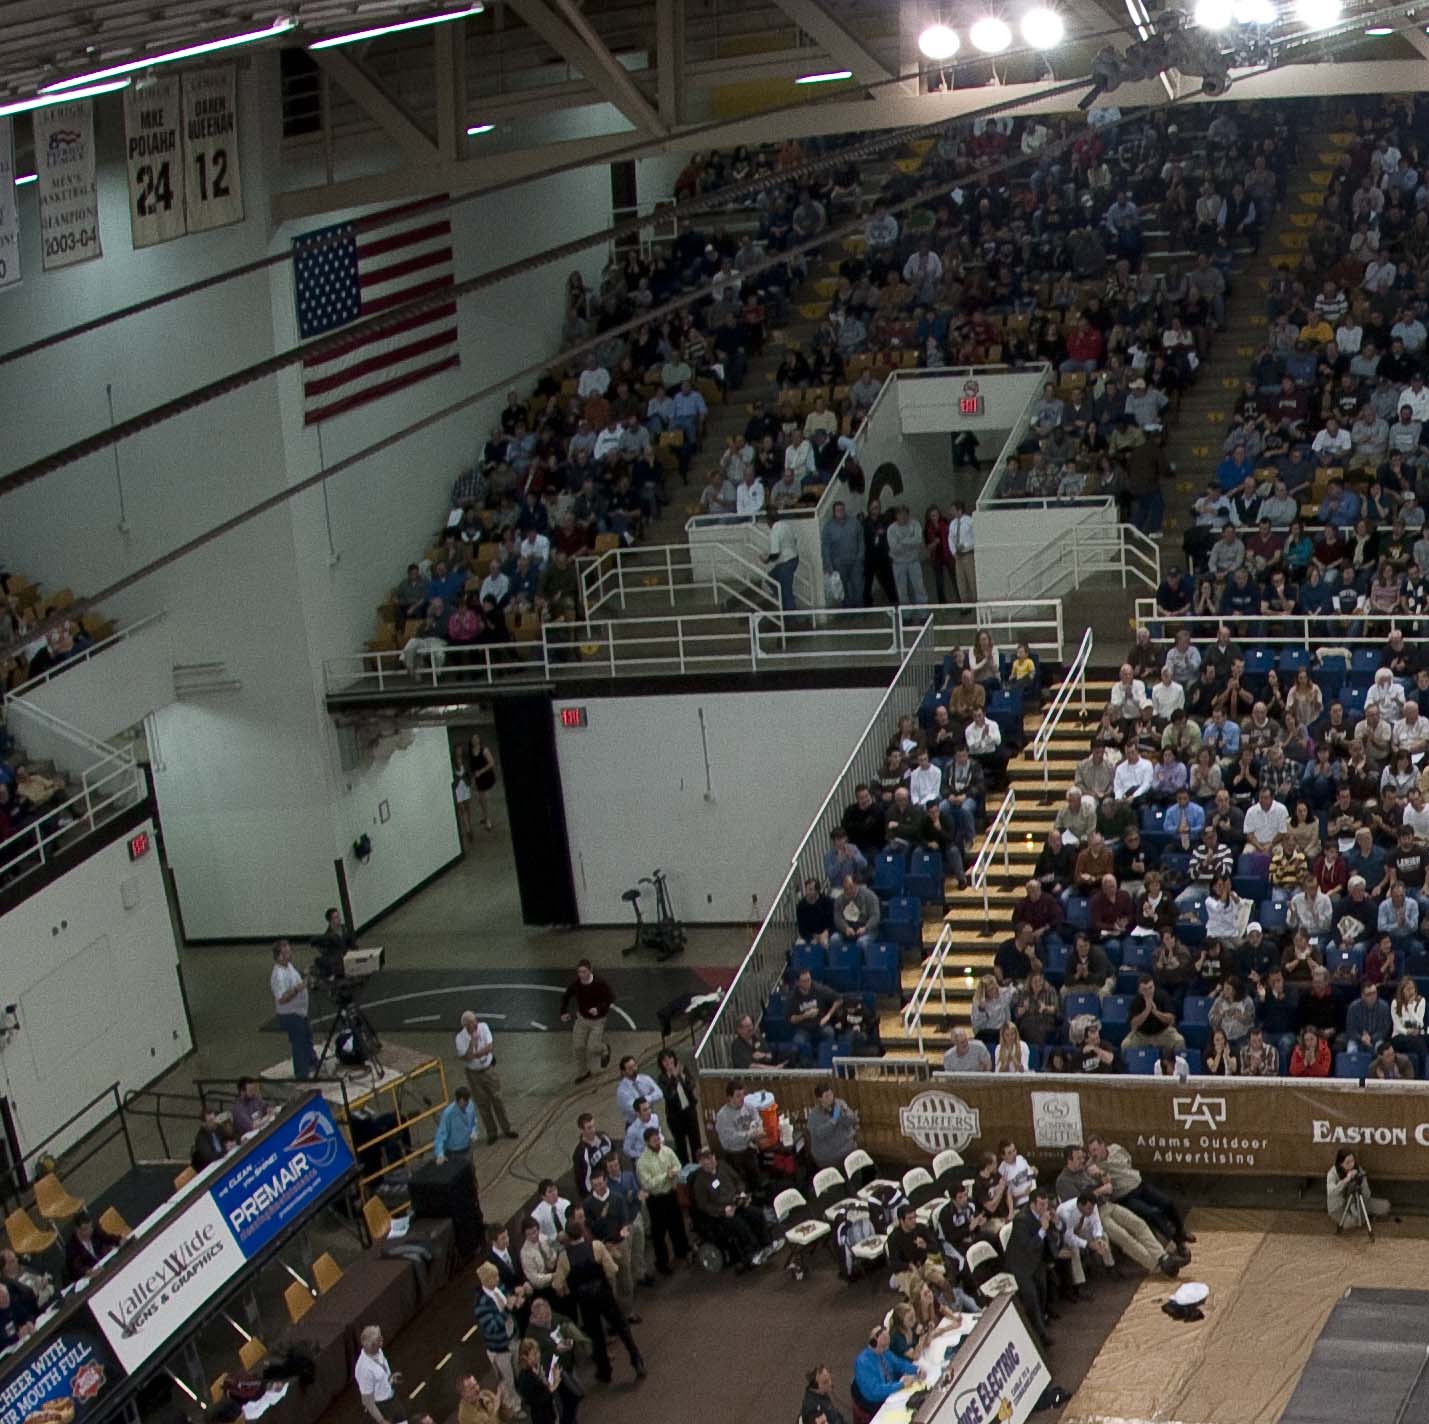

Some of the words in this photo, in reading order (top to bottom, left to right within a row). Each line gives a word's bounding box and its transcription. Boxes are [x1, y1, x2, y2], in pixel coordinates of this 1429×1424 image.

[136, 161, 174, 216] 24
[194, 150, 230, 200] 12
[46, 227, 96, 257] 2003-04
[906, 1114, 975, 1133] STARTERS
[1136, 1135, 1190, 1148] Adams
[1200, 1136, 1268, 1150] Outdoor
[1312, 1119, 1407, 1147] EASTON
[1153, 1150, 1255, 1166] Advertising
[230, 1152, 309, 1232] PREMAIR
[172, 1240, 224, 1292] GRAPHICS
[31, 1338, 68, 1375] WITH
[976, 1341, 1020, 1414] ELECTRIC
[21, 1370, 62, 1417] MOUTH
[60, 1342, 92, 1376] FULL
